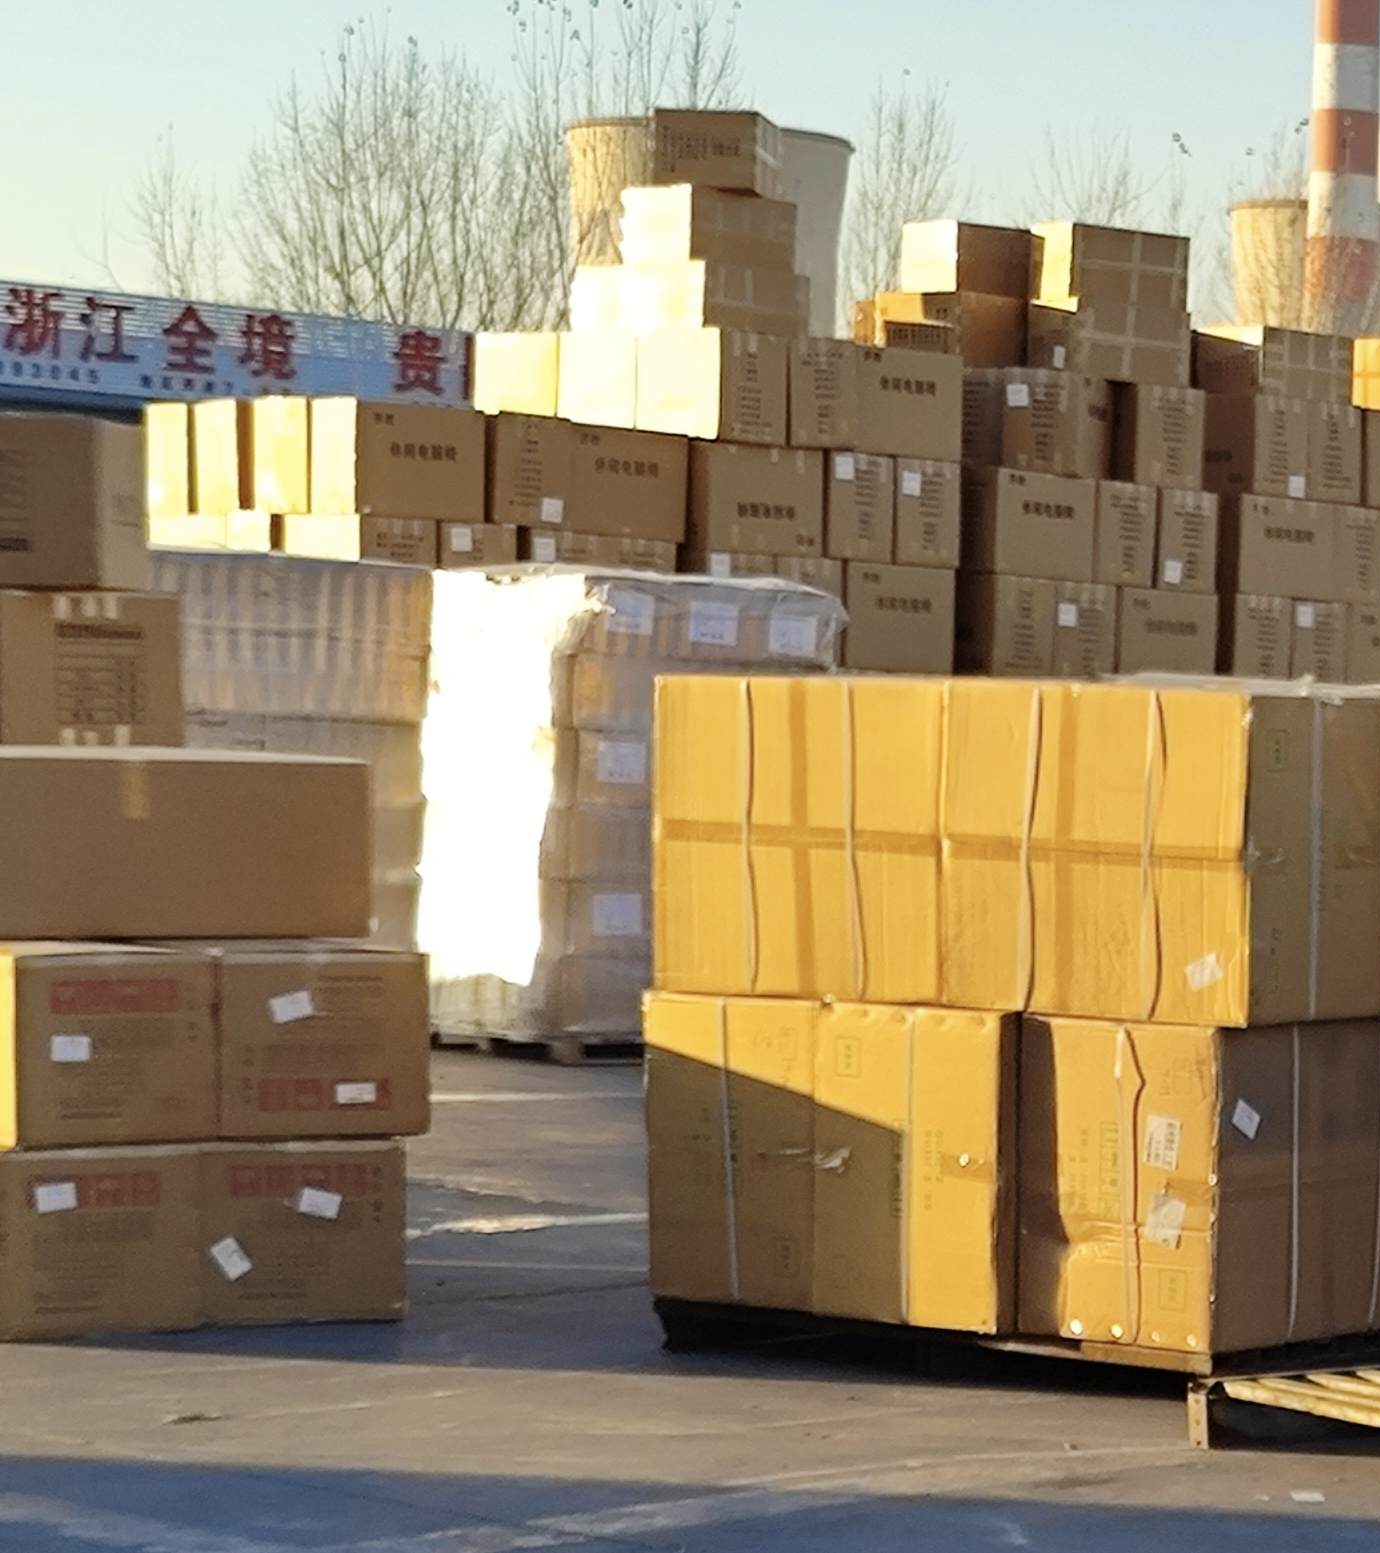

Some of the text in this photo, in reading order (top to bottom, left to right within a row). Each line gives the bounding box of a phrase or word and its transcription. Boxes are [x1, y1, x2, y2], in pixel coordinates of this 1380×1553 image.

[4, 287, 446, 396] 浙江全境 贵
